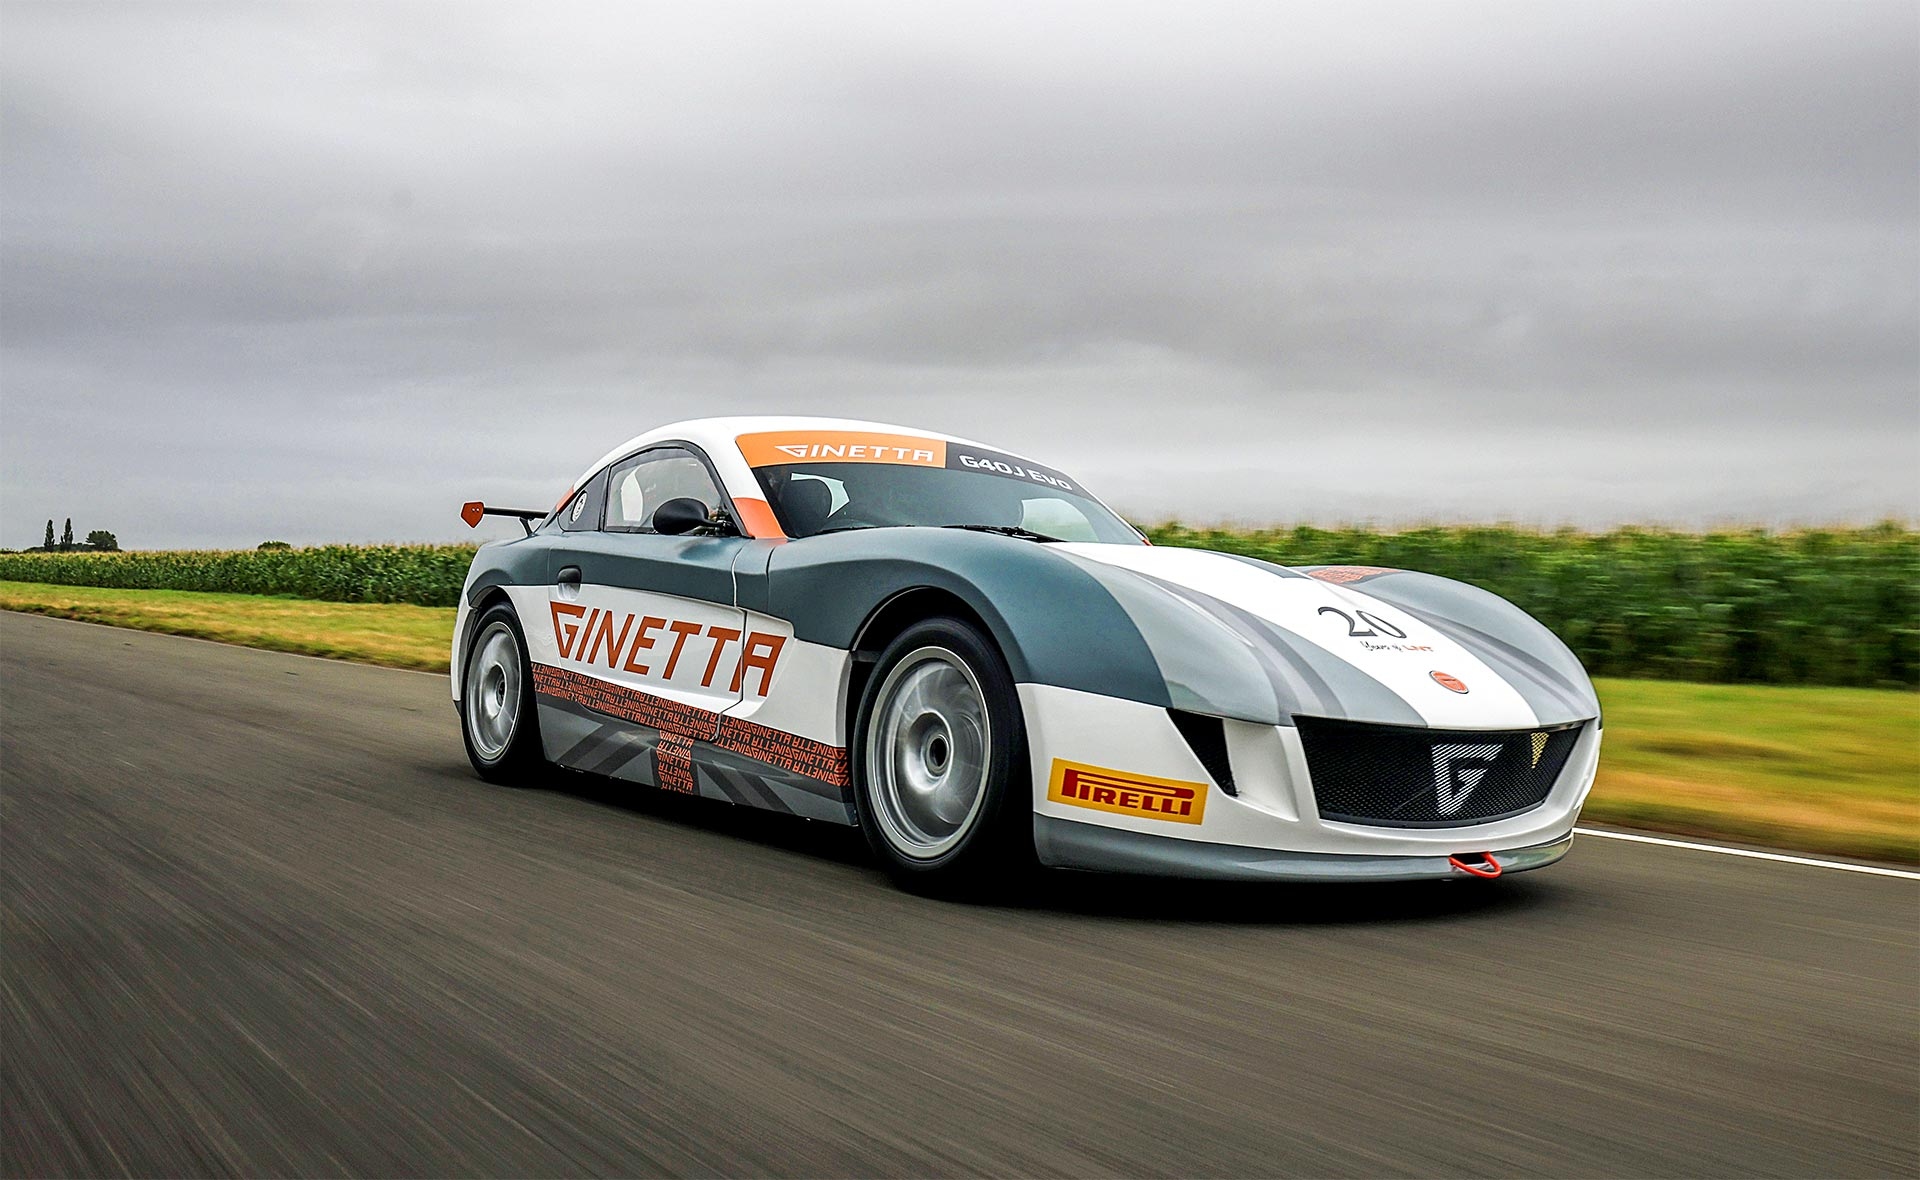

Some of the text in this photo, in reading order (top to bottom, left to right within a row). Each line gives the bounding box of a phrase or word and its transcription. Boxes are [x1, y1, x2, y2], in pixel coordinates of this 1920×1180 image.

[775, 444, 934, 462] GINETTA
[959, 455, 1073, 491] G40J EVO
[1317, 606, 1407, 638] 20
[550, 601, 787, 697] GINETTA
[660, 730, 695, 748] GINETTA
[672, 701, 709, 720] GINETTA
[710, 714, 751, 732] GINETA
[750, 723, 791, 744] GINETTA
[792, 736, 835, 759] GINETTA
[673, 713, 710, 733] GINETTA
[709, 723, 751, 743] GNETTA
[751, 736, 793, 758] GINETTA
[791, 748, 835, 770] GINETTA
[751, 748, 792, 770] GINETTA
[792, 761, 836, 785] GINETTA
[1061, 768, 1195, 816] PIRELLI
